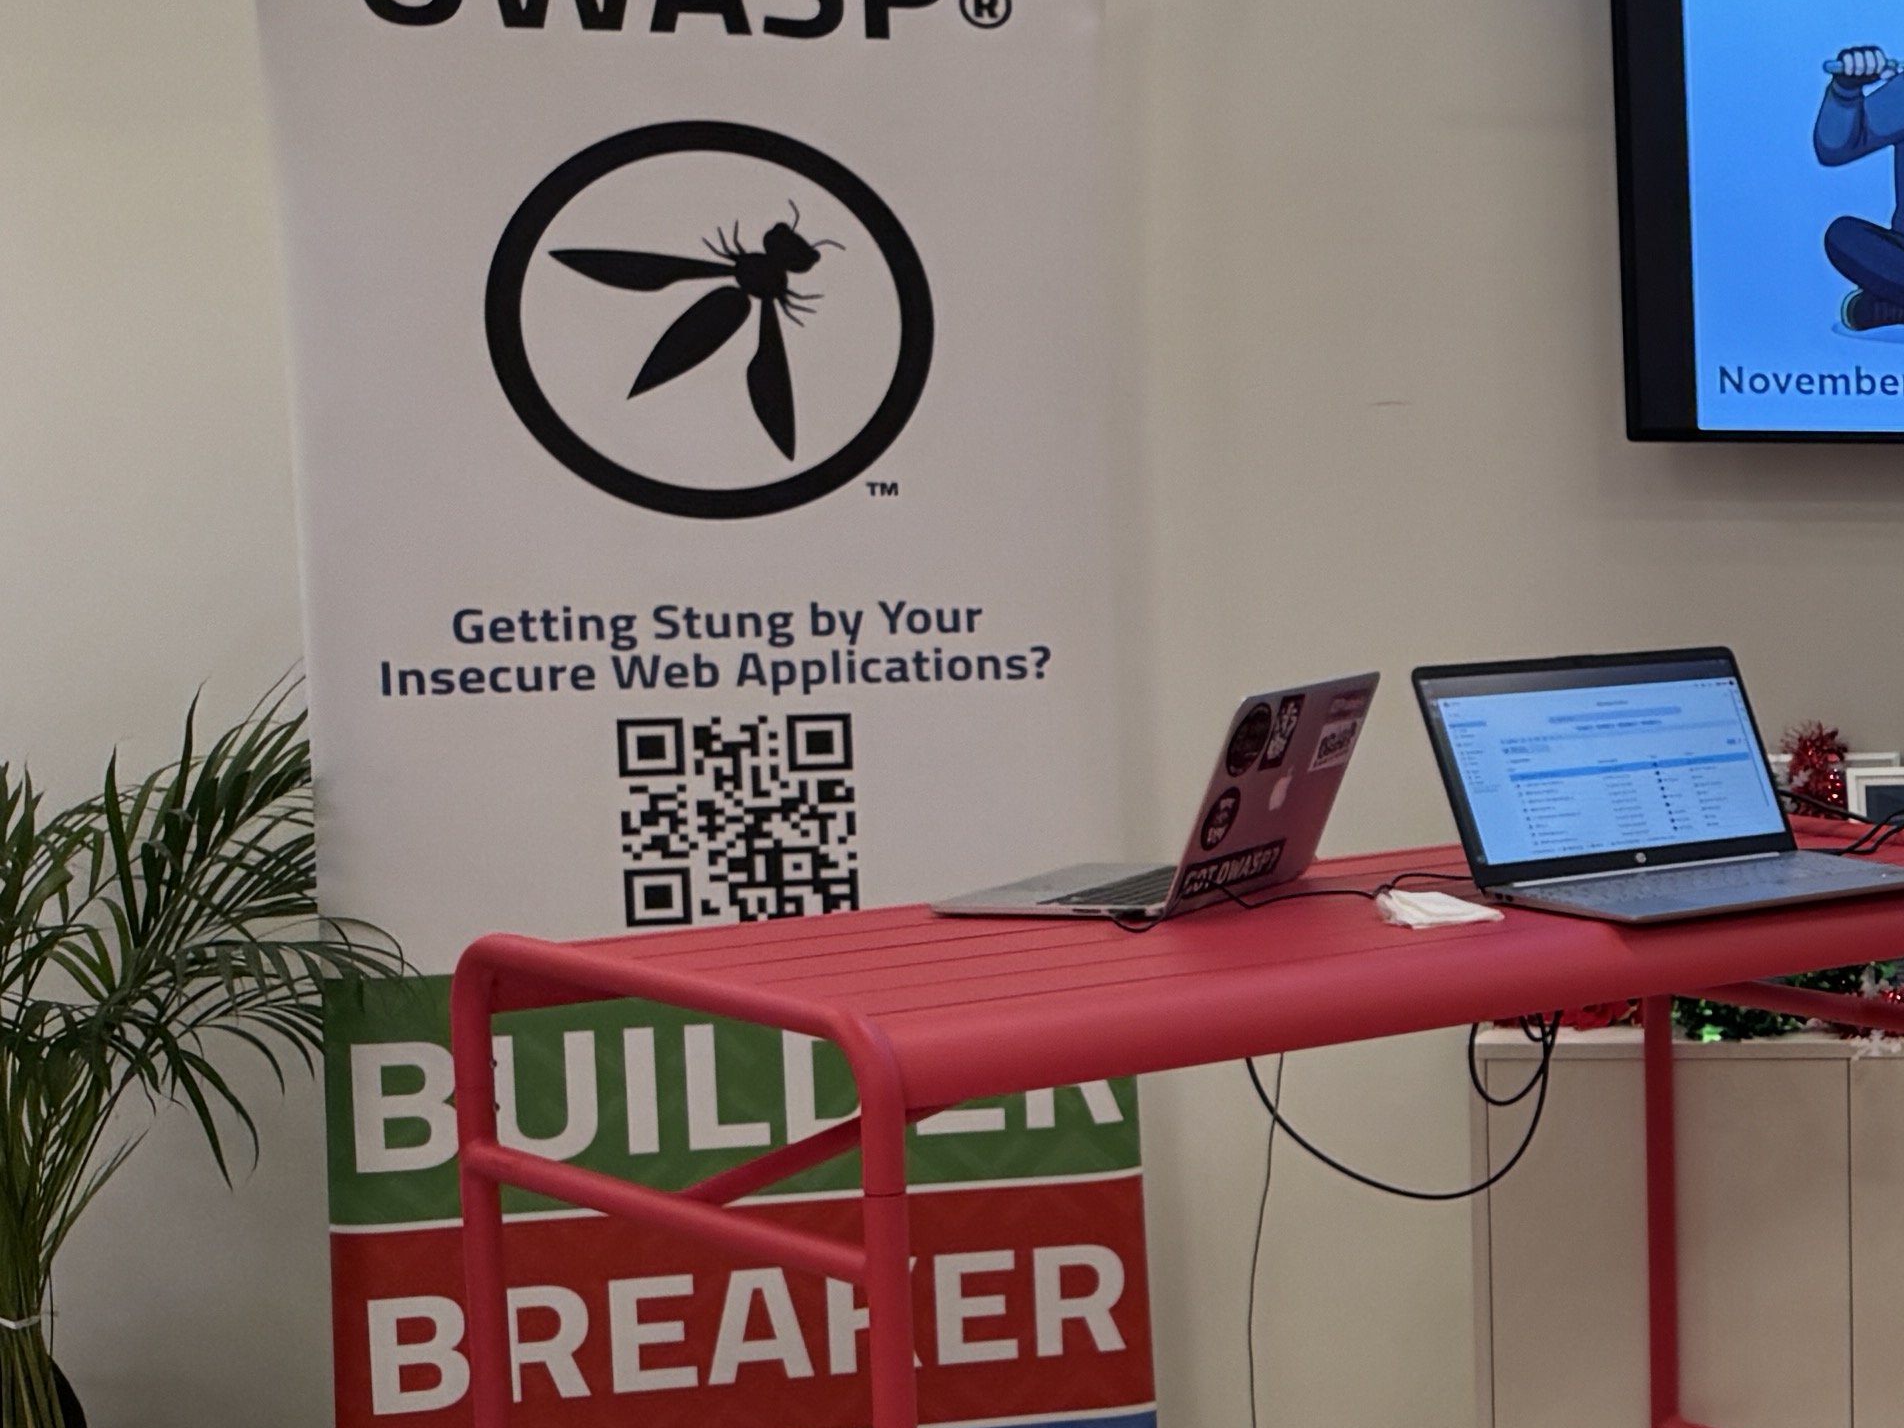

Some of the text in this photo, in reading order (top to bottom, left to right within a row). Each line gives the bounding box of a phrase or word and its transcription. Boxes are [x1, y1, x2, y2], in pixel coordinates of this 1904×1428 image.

[866, 481, 899, 497] TM
[451, 599, 984, 654] Getting Stung by Your
[379, 645, 1053, 698] Insecure Web Applications?
[350, 1023, 1125, 1175] BUILD
